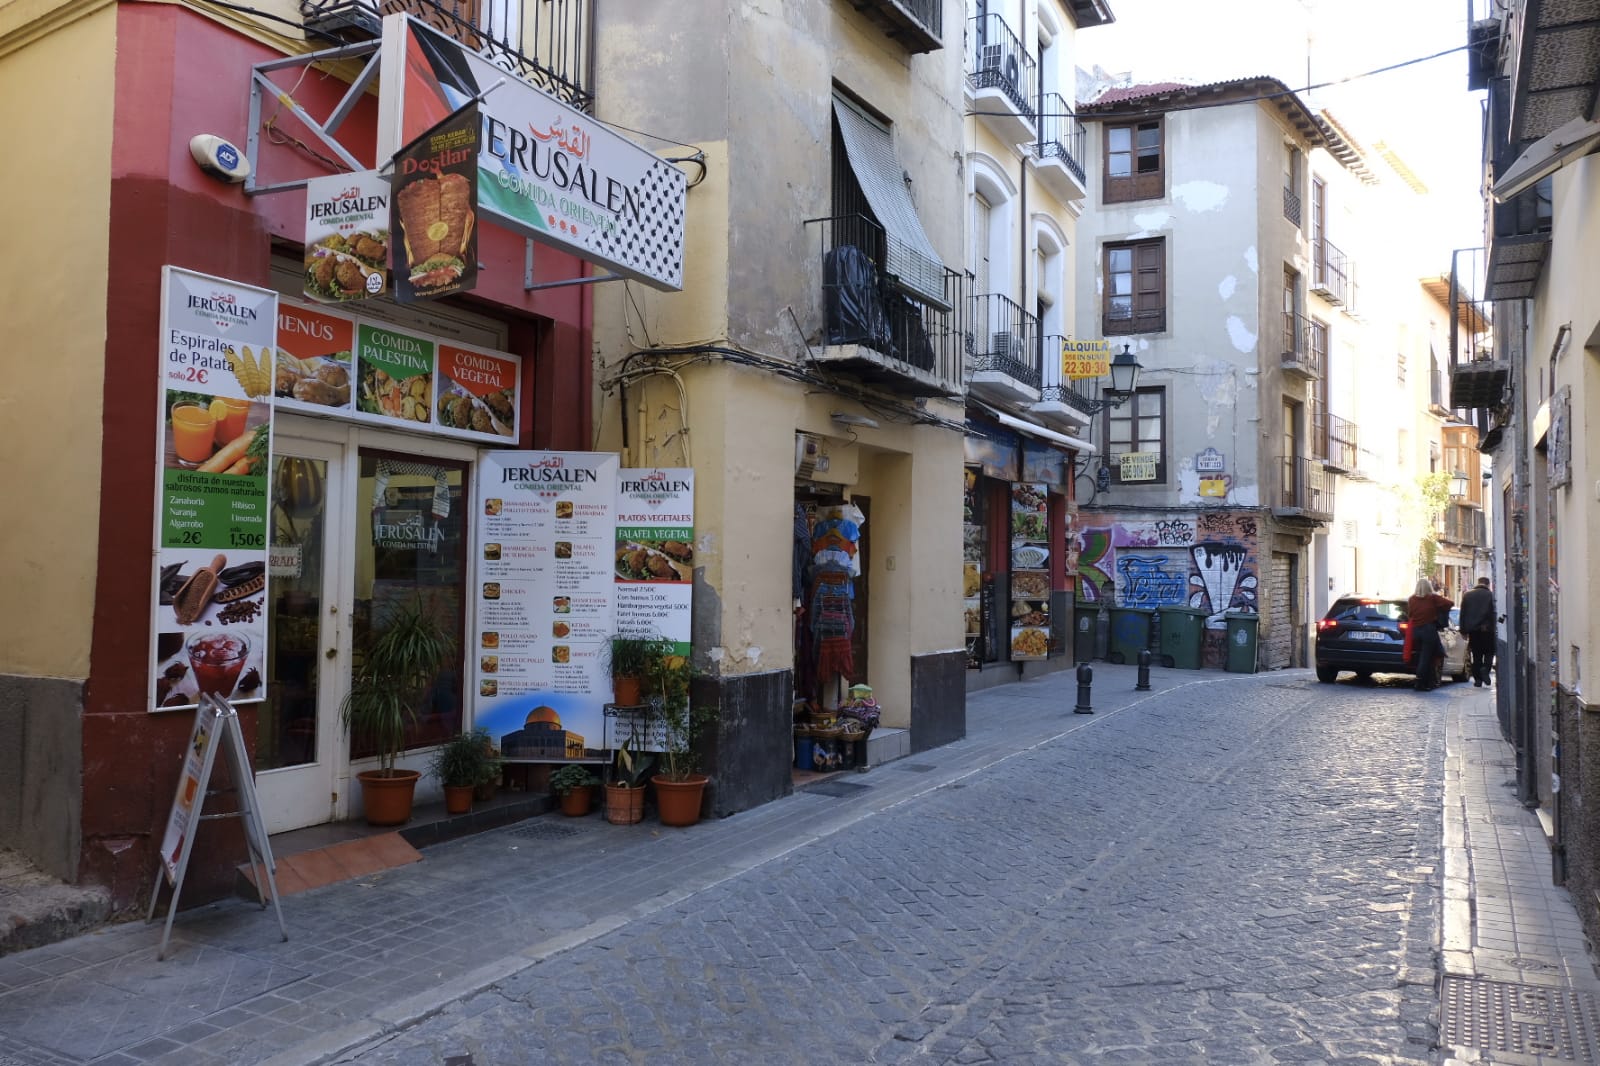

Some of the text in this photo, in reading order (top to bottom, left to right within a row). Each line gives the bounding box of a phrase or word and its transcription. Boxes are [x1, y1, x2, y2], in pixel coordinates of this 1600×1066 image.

[498, 168, 558, 212] COMIDA
[310, 195, 387, 220] JERUSALEN
[320, 212, 374, 226] COMIDA ORIENTAL
[188, 295, 257, 320] JERUSALEN
[195, 309, 249, 326] COMIDA PALESTINA
[171, 329, 235, 355] Espirales
[371, 331, 423, 356] COMIDA
[1063, 342, 1108, 352] ALQUILA
[169, 348, 235, 372] de Patata
[363, 345, 429, 372] PALESTINA
[455, 352, 502, 374] COMIDA
[168, 367, 209, 384] solo 2€
[452, 366, 504, 388] VEGETAL
[177, 473, 255, 488] disfruta de nuestros
[502, 468, 597, 483] JERUSALEN
[165, 482, 265, 497] sabrosos zumos naturales
[514, 483, 582, 491] COMIDA ORIENTAL
[620, 481, 690, 494] JERUSALEN
[169, 507, 198, 518] Naranja
[231, 501, 256, 510] Hibisco
[618, 514, 691, 522] PLATOS VEGETALES
[182, 531, 202, 545] 2€
[230, 533, 265, 547] 1,50€
[618, 529, 690, 539] FALAFEL VEGETAL
